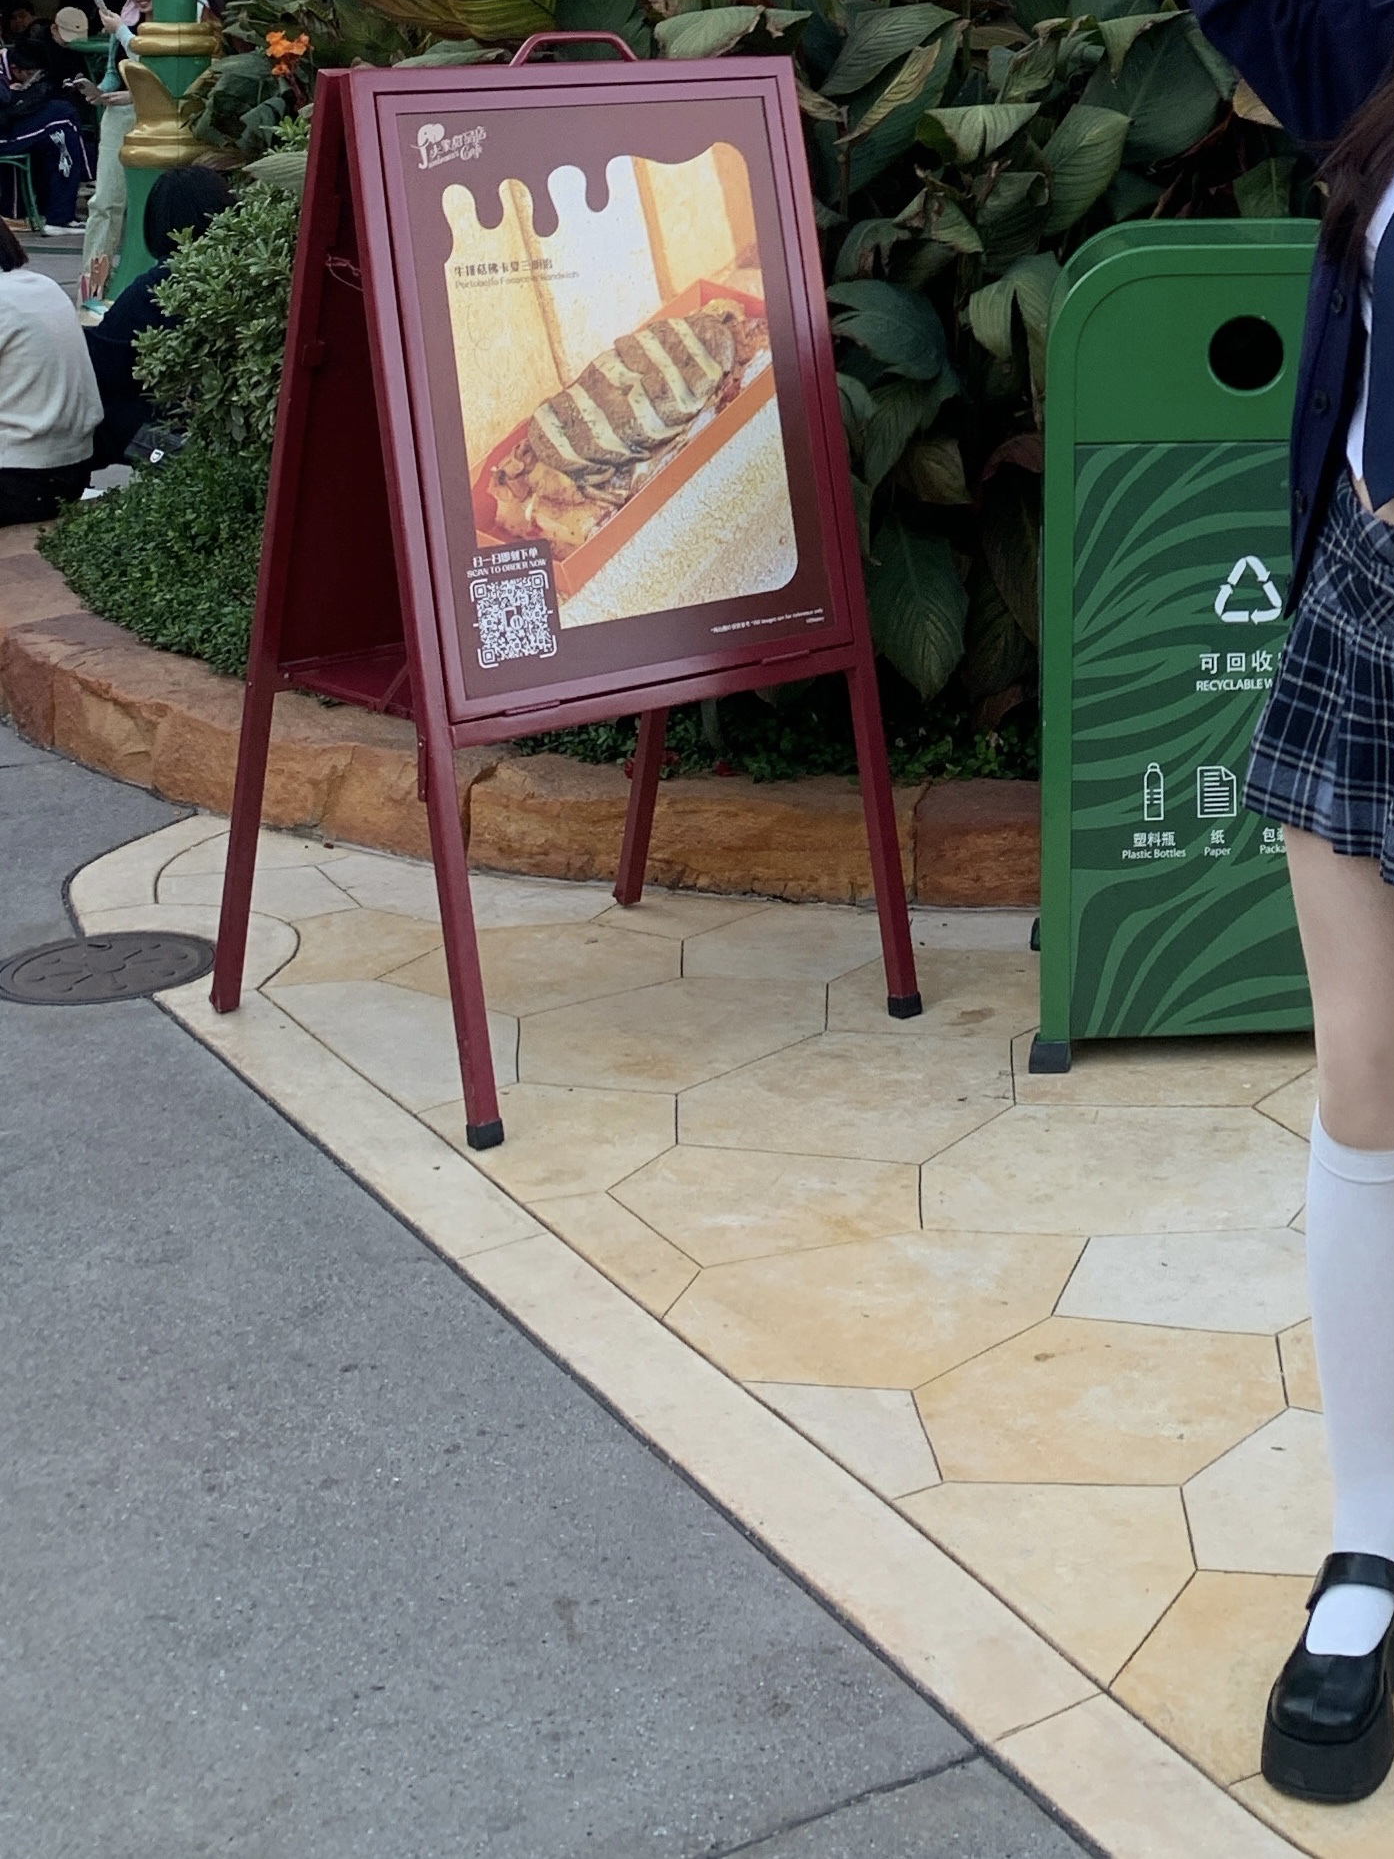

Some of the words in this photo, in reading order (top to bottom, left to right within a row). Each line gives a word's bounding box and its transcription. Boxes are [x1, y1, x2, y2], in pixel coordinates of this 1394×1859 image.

[466, 568, 490, 579] SCAN
[490, 565, 502, 575] TO
[1198, 649, 1283, 675] 可回收
[1195, 677, 1264, 692] RECYCLABLE
[1132, 831, 1177, 848] 塑料瓶
[1210, 829, 1225, 844] 纸
[1121, 848, 1152, 860] Plastic
[1153, 847, 1187, 859] Bottles
[1203, 846, 1231, 858] Paper
